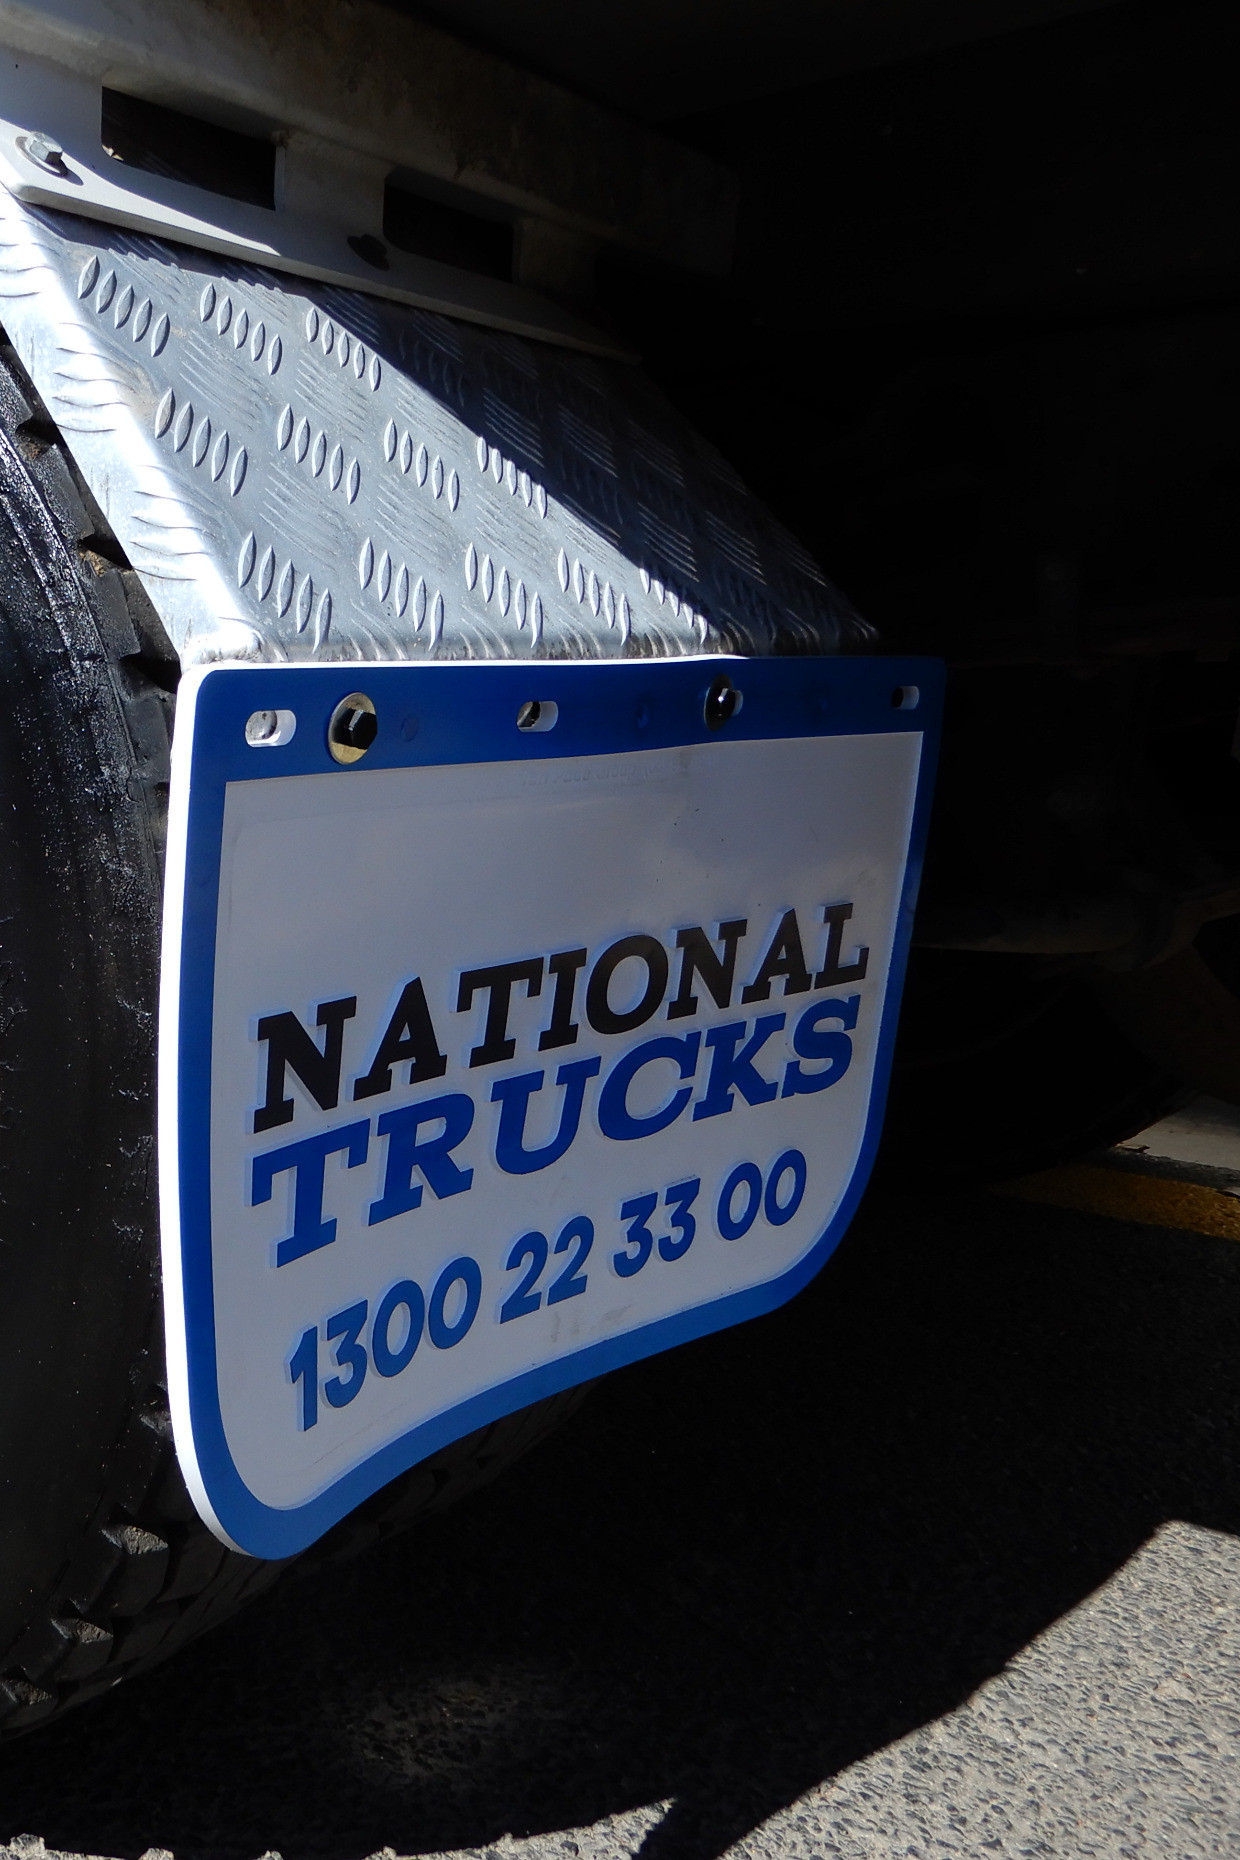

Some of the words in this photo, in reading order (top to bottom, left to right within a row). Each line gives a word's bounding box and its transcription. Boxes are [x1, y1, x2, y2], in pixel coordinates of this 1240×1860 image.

[249, 994, 861, 1268] TRUCKS
[250, 902, 869, 1134] NATIONAL
[286, 1255, 482, 1432] 1300
[497, 1214, 595, 1325] 22
[612, 1177, 701, 1278] 33
[715, 1148, 807, 1242] 00
